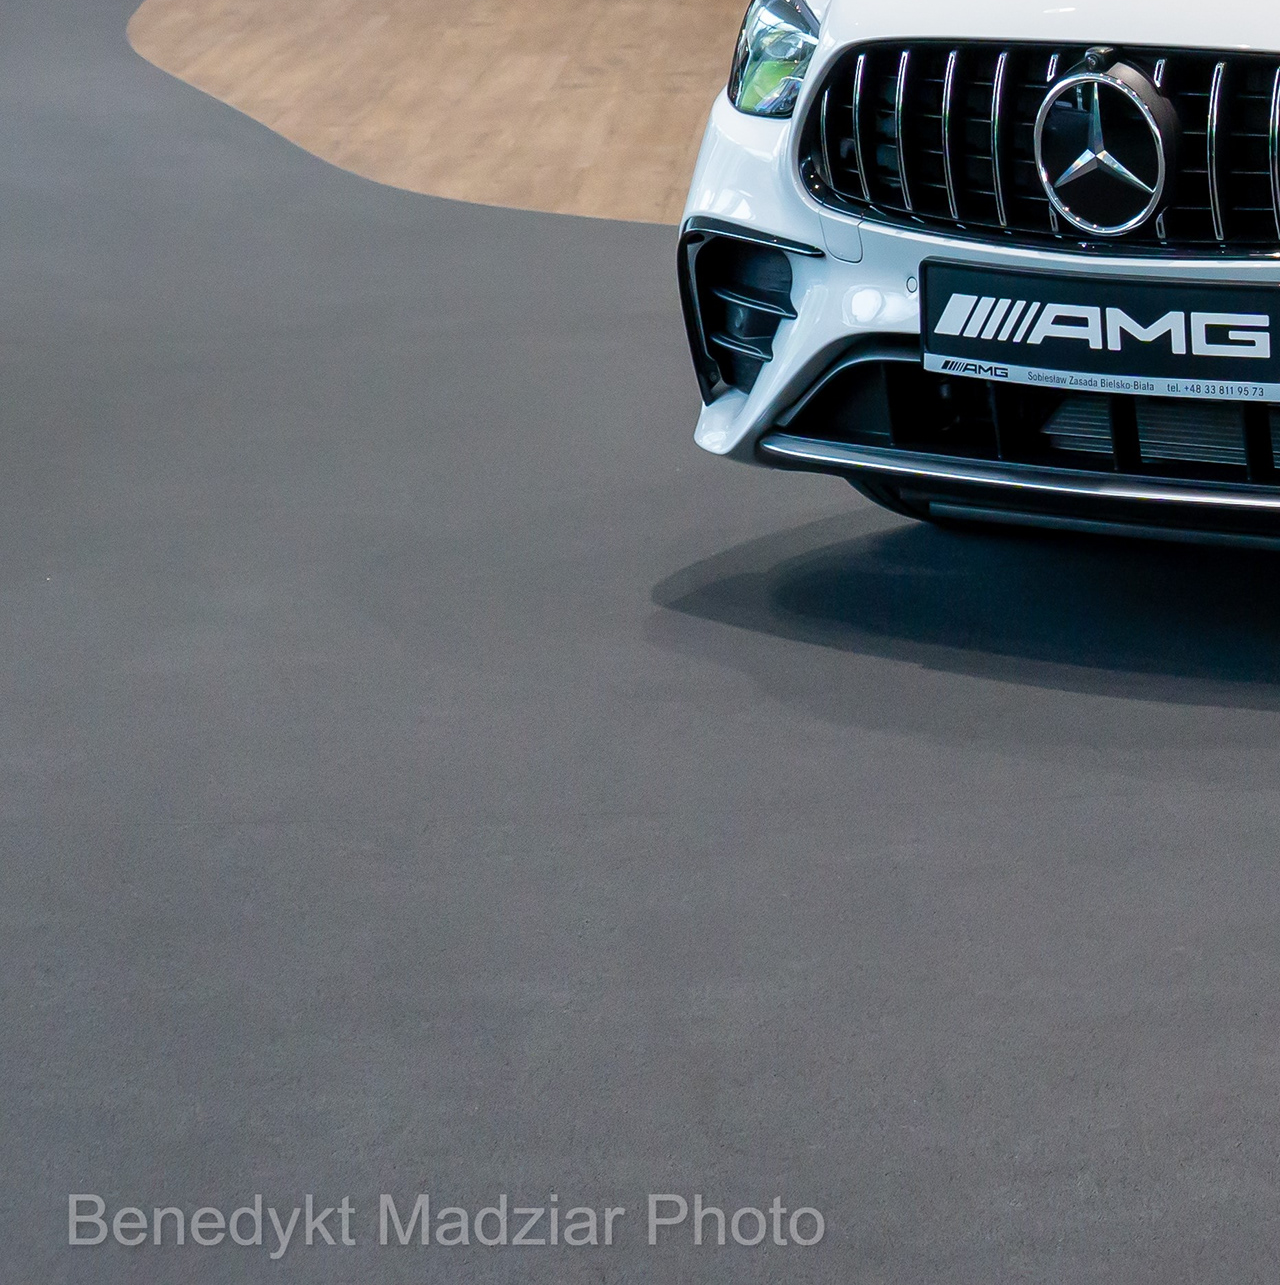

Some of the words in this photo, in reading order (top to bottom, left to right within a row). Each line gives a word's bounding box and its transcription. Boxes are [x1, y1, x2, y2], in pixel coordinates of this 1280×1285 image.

[1026, 302, 1271, 358] AMG
[962, 362, 1009, 378] AMG
[1069, 375, 1098, 387] Zasada
[1167, 383, 1181, 393] tel.
[1184, 384, 1201, 394] +48
[1204, 385, 1216, 395] 33
[1219, 385, 1234, 395] 811
[1238, 386, 1249, 396] 95
[1252, 386, 1264, 397] 73
